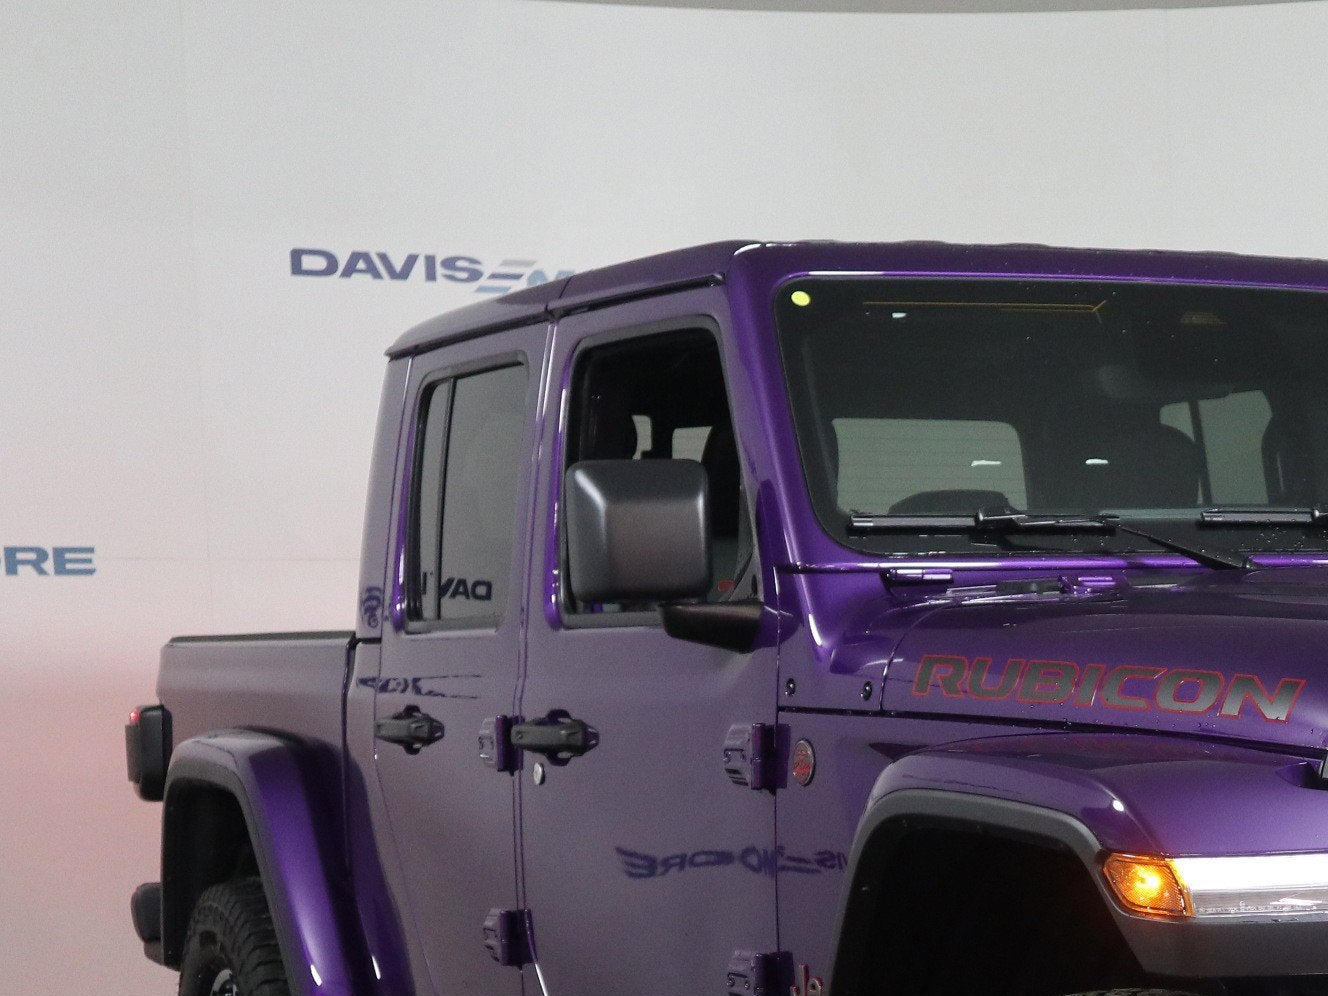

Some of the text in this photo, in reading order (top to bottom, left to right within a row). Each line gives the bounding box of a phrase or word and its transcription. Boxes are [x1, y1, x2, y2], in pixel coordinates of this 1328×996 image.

[289, 248, 484, 283] DAVIS
[0, 546, 96, 576] RE
[912, 654, 1307, 724] RUBICON
